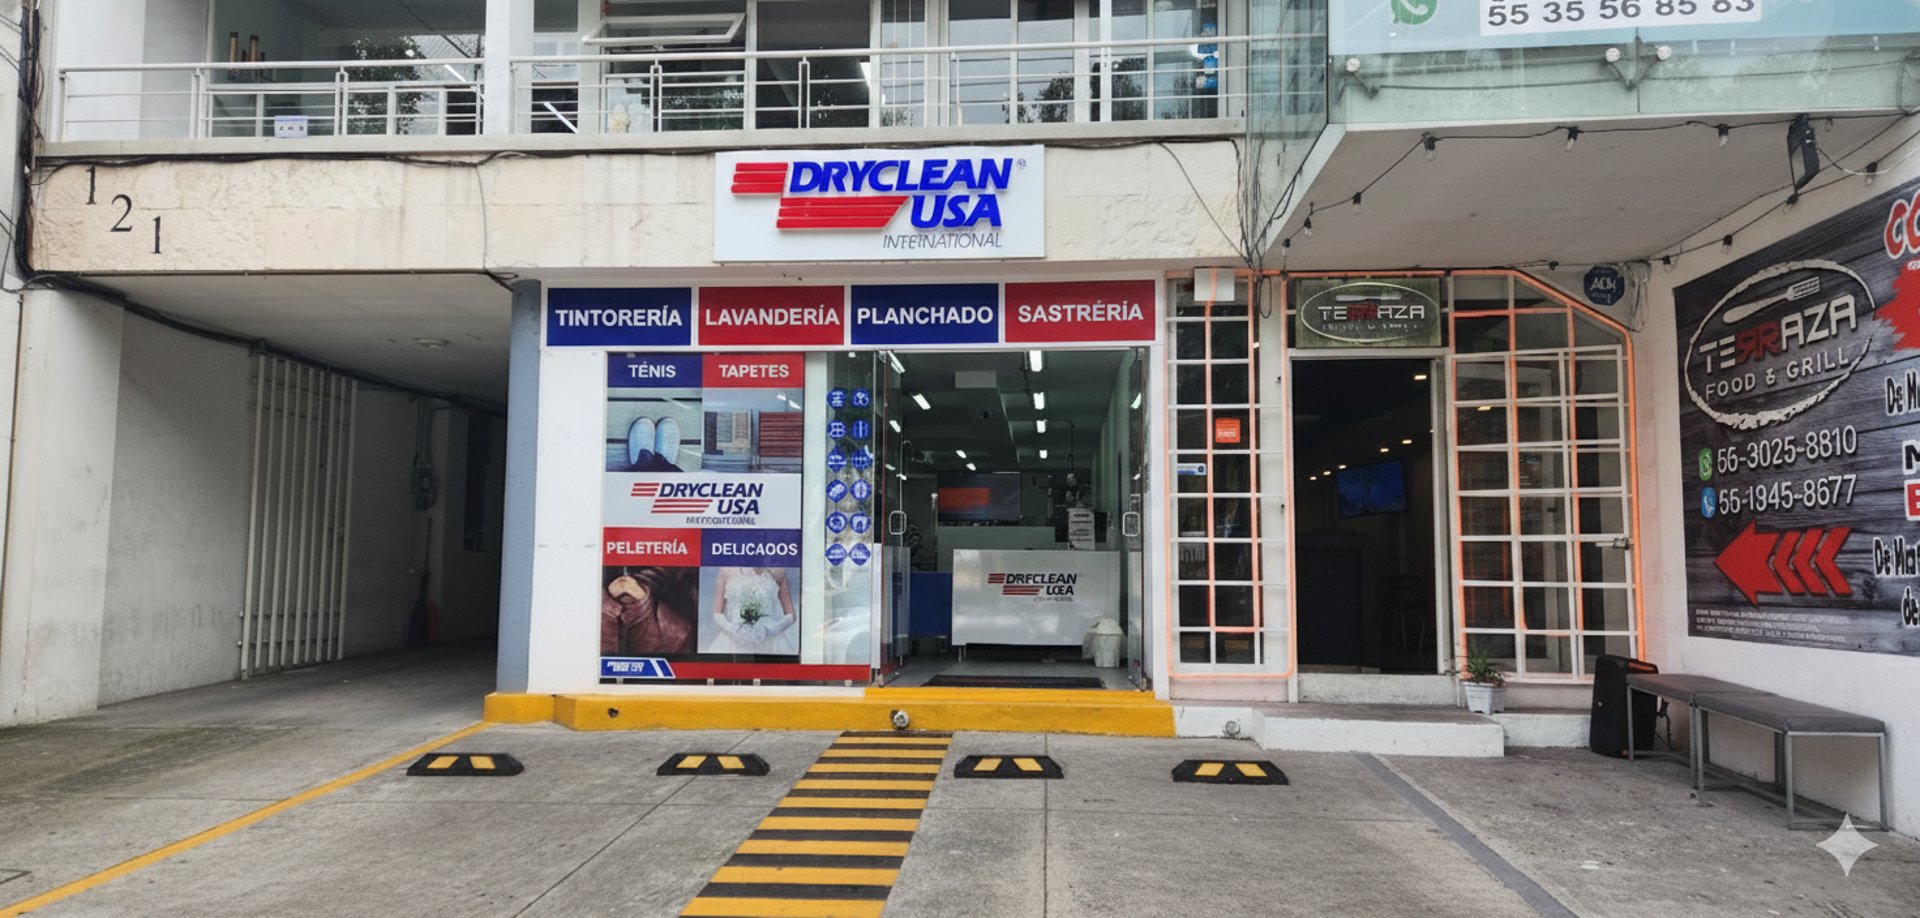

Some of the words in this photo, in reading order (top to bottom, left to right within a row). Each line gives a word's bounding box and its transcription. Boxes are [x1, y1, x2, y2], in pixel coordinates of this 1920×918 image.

[1488, 4, 1530, 26] 55
[1542, 1, 1585, 23] 35
[1599, 0, 1641, 19] 56
[1655, 0, 1697, 16] 85
[789, 158, 1013, 193] DRYCLEAN
[910, 193, 1003, 229] USA
[555, 305, 683, 327] TINTORERÍA
[705, 304, 841, 326] LAVANDERÍA
[857, 306, 994, 325] PLANCHADO
[628, 361, 677, 378] TÉNIS
[718, 364, 790, 378] TAPETES
[1706, 373, 1756, 400] FOOD
[1786, 347, 1849, 379] GRILL
[659, 483, 764, 497] DRYCLEAN
[717, 499, 760, 515] USA
[606, 538, 688, 555] PELETERÍA
